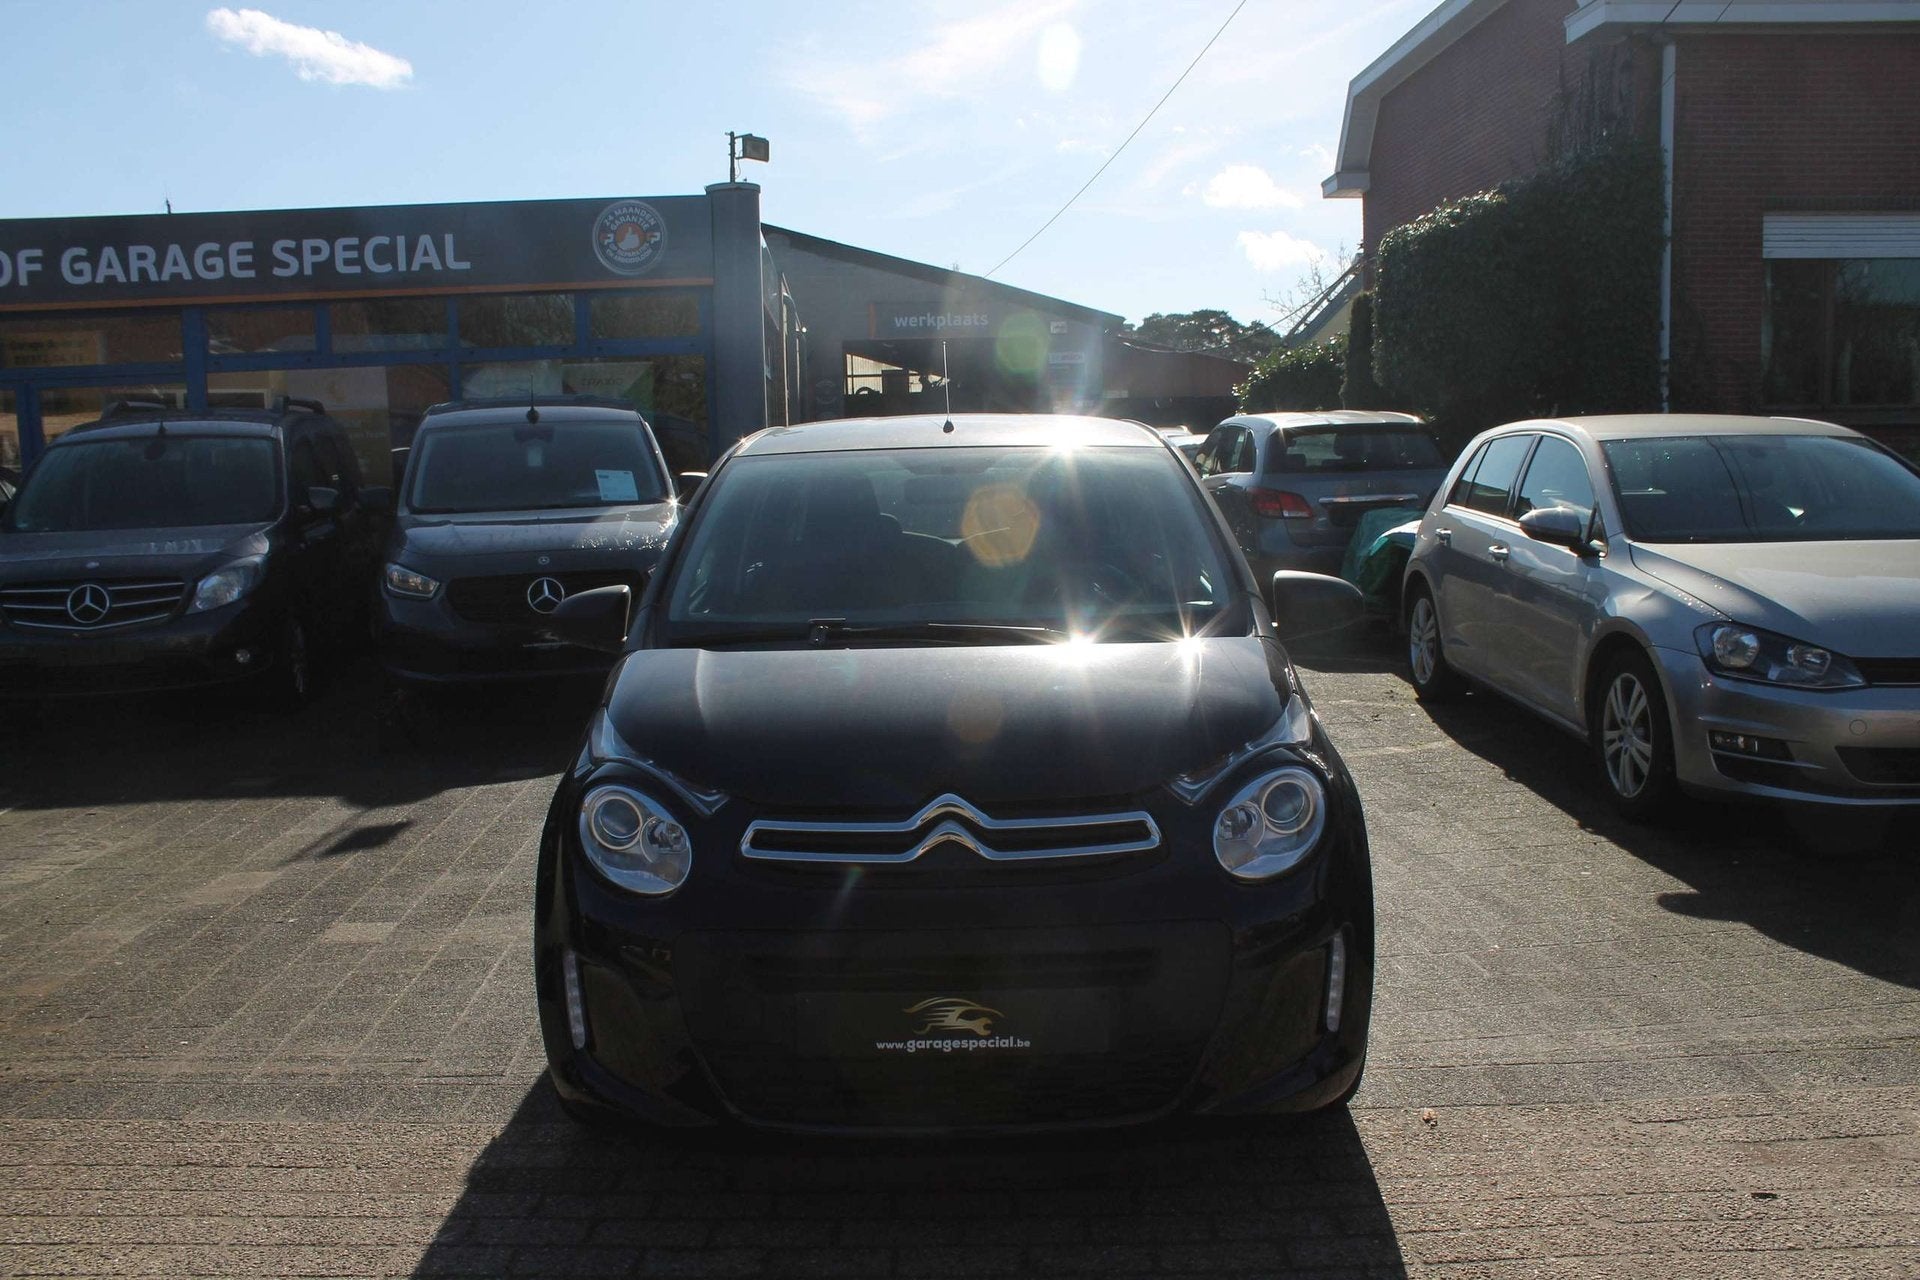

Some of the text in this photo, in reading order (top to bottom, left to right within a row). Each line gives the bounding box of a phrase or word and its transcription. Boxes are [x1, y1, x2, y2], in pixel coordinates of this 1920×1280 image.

[611, 215, 650, 231] GARANTIE
[614, 207, 656, 226] MAANDEN
[61, 242, 256, 286] GARAGE
[271, 233, 471, 277] SPECIAL
[894, 312, 989, 330] werkplaats
[876, 1035, 1031, 1053] www.garagespecial.be
